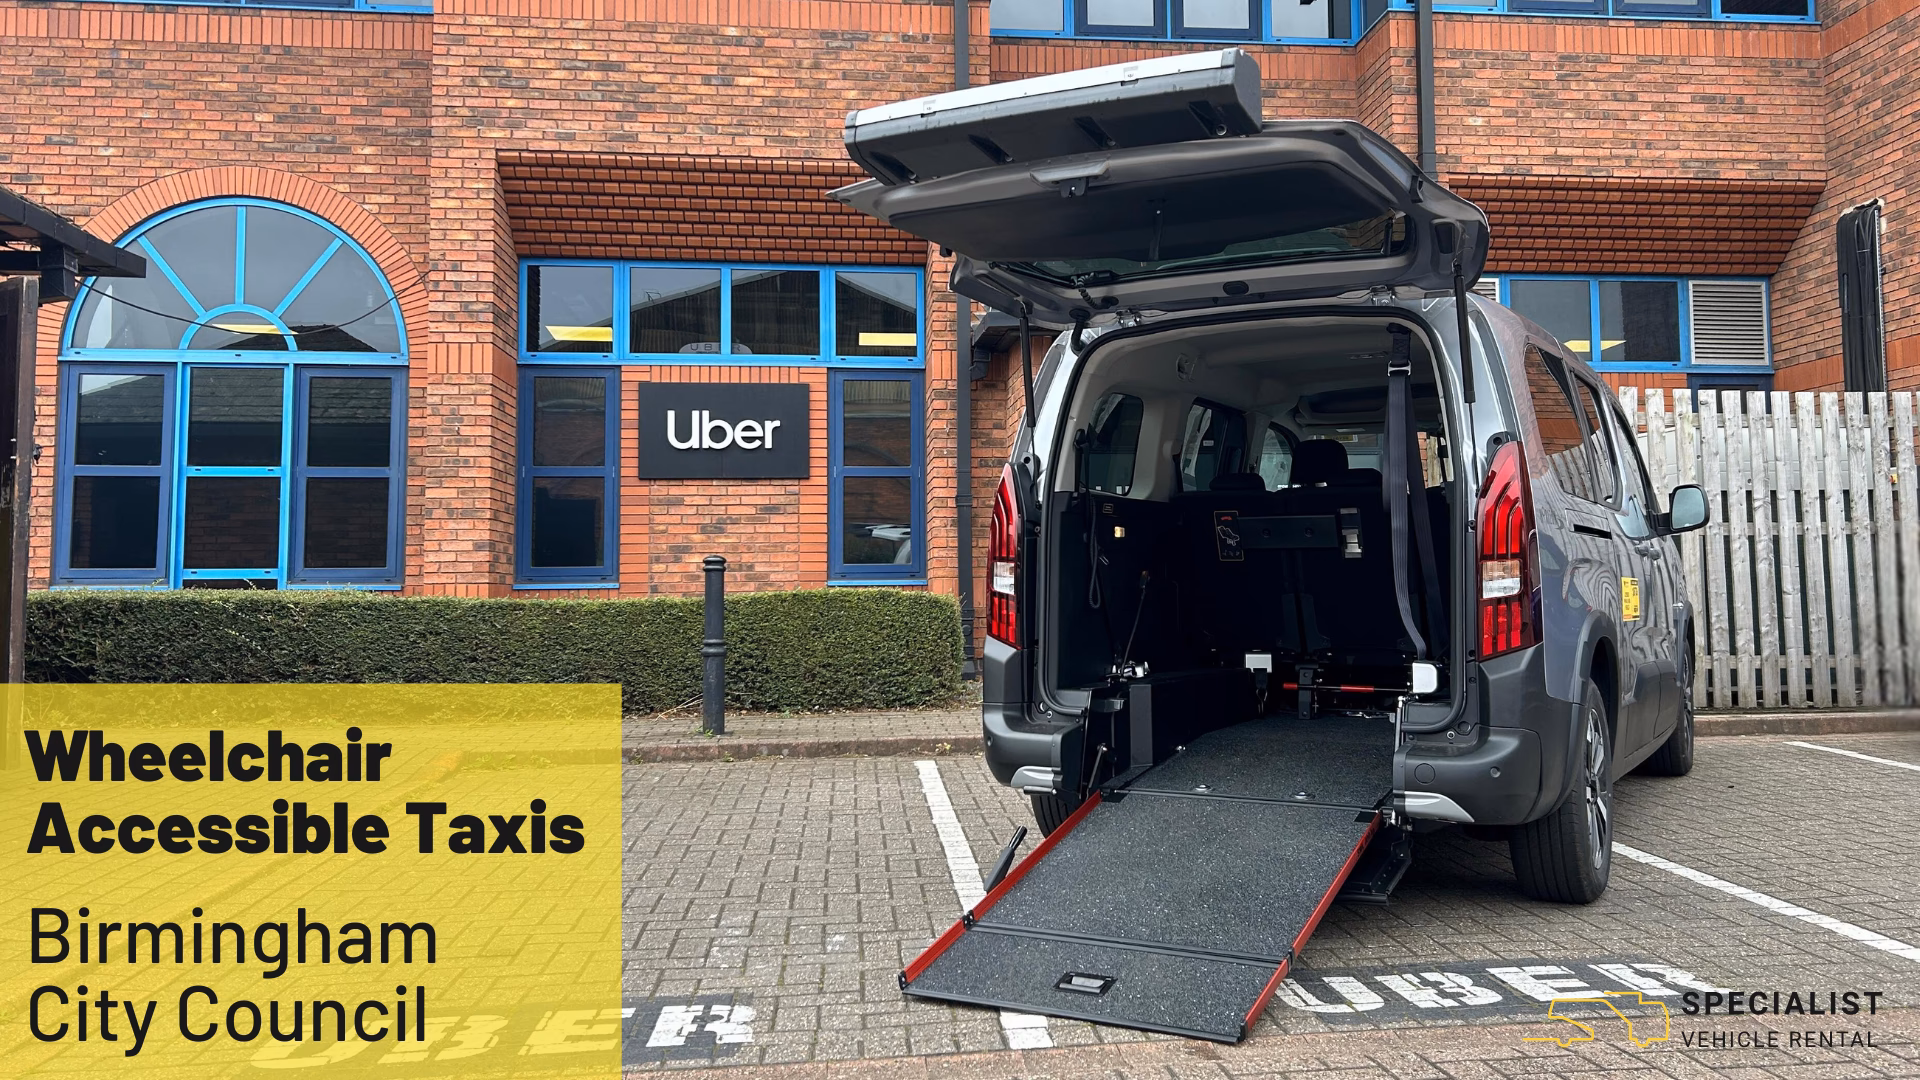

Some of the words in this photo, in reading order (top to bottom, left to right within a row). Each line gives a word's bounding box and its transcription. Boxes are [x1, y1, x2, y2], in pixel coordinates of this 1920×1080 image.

[690, 343, 741, 352] UBR
[667, 409, 781, 450] Uber
[1274, 963, 1735, 1014] UBER
